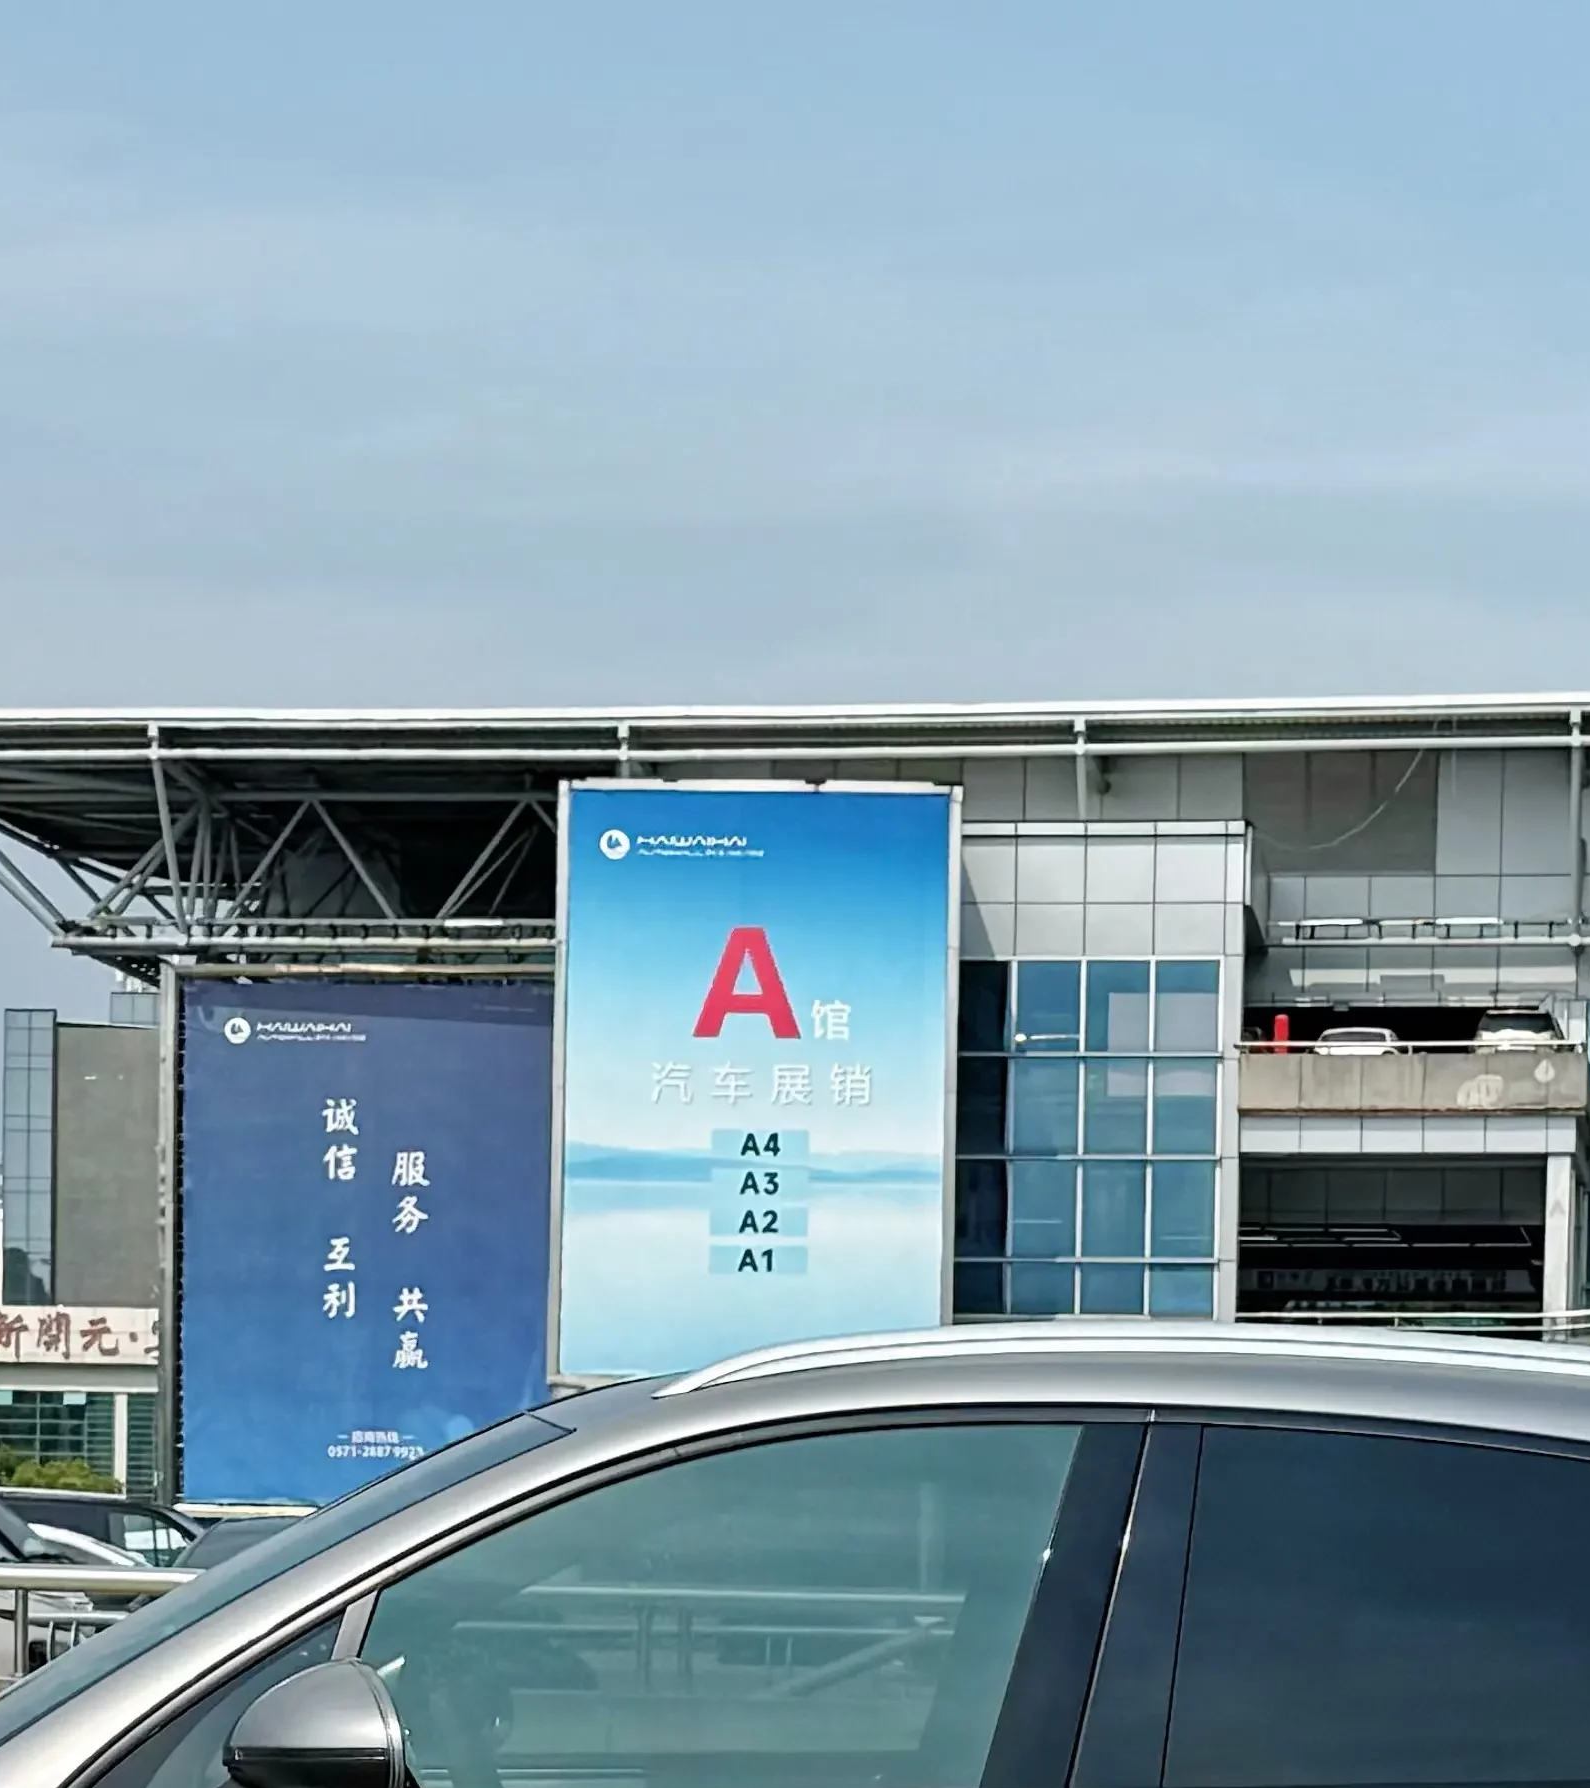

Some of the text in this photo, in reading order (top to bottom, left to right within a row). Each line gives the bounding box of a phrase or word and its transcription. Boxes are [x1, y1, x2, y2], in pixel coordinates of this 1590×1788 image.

[651, 1060, 873, 1106] 汽车展销
[740, 1131, 781, 1158] A4
[739, 1170, 780, 1195] A3
[322, 1098, 359, 1319] 诚信 互利
[738, 1209, 780, 1234] A2
[391, 1150, 430, 1370] 服务 共赢
[737, 1248, 775, 1273] A1
